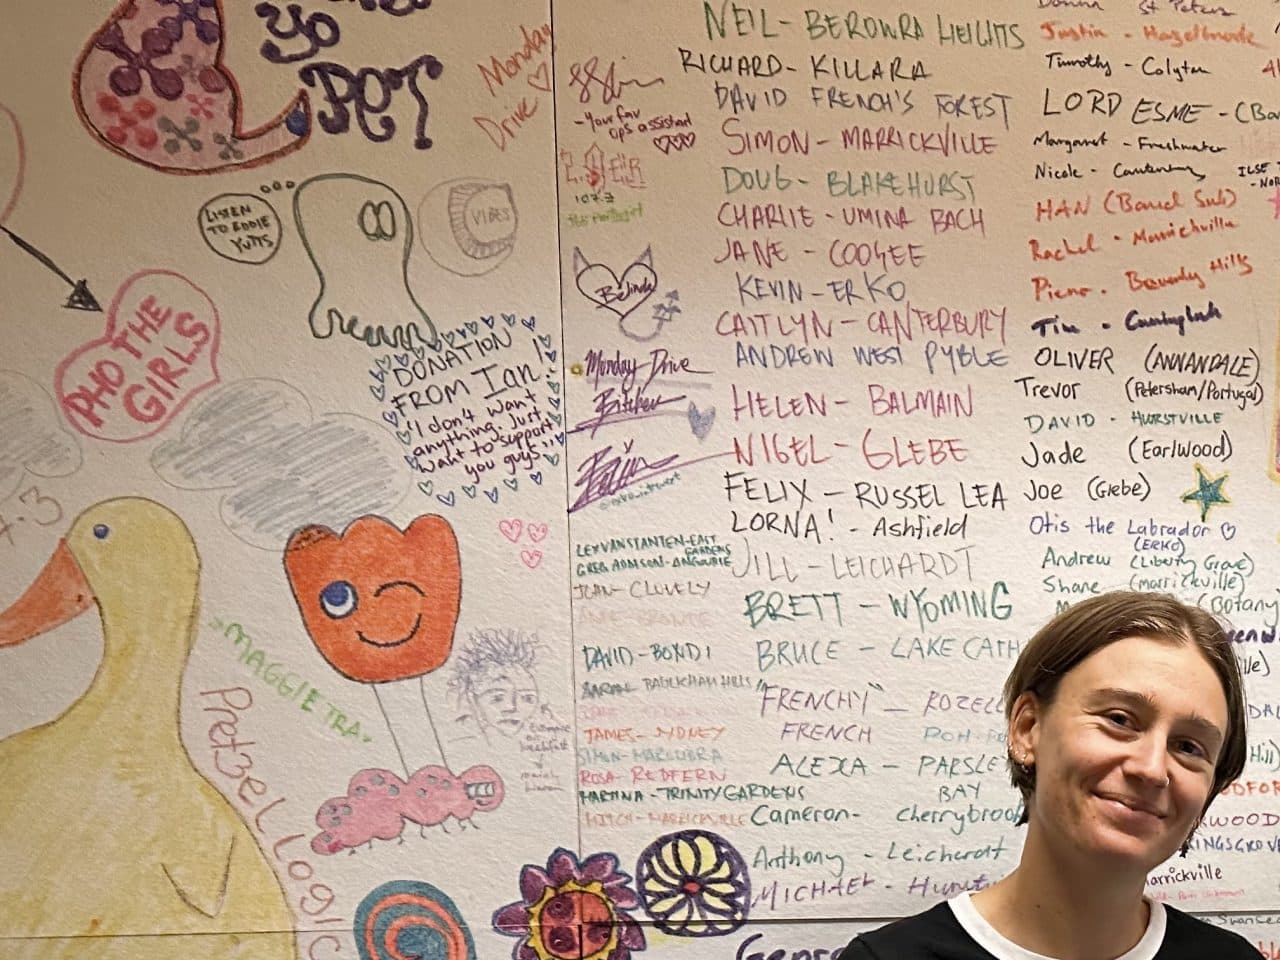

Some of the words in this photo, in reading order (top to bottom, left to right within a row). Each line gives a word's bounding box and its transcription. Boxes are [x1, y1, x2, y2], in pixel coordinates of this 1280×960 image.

[810, 57, 933, 81] KILLARA
[714, 81, 788, 112] DAVID
[1043, 88, 1122, 117] LORD
[475, 97, 538, 151] Drive
[722, 118, 809, 156] SIMON
[828, 173, 975, 203] BLAKEHURST
[930, 207, 986, 237] BACH
[1035, 196, 1090, 222] HAN
[714, 240, 789, 268] JANE
[828, 240, 926, 272] COOGEE
[113, 296, 171, 360] THE
[715, 311, 832, 340] CAITLYN
[867, 303, 1008, 342] CANTERBURY
[122, 311, 210, 423] GIRLS
[393, 327, 512, 388] DONATION
[736, 341, 833, 370] ANDREW
[1035, 347, 1114, 374] OLIVER
[1144, 344, 1260, 386] (ANNANDALE)
[68, 362, 127, 430] PHO
[392, 379, 470, 417] FROM
[487, 388, 536, 417] want
[731, 384, 828, 419] HELEN
[868, 384, 974, 419] BALMAIN
[1014, 376, 1081, 400] Trevor
[1025, 412, 1097, 433] DAVID
[1132, 410, 1225, 427] HURSTVILLE
[417, 449, 465, 473] want
[471, 440, 494, 456] to
[500, 418, 553, 449] support
[734, 434, 830, 468] NIGEL
[862, 427, 969, 471] GLEBE
[1021, 442, 1087, 467] Jade
[465, 459, 495, 484] you
[724, 471, 812, 503] FELIX
[855, 480, 946, 511] RUSSEL
[959, 483, 1008, 512] LEA
[1024, 479, 1064, 502] Joe
[872, 513, 969, 539] Ashfield
[1029, 515, 1071, 535] Otis
[1085, 517, 1115, 536] the
[1127, 518, 1211, 539] Labrador
[730, 544, 800, 583] JILL
[1042, 546, 1112, 570] Andrew
[1043, 575, 1099, 595] Shane
[743, 590, 843, 629] BRETT
[888, 581, 1013, 644] WYOMING
[755, 639, 839, 672] BRUCE
[890, 637, 956, 660] LAKE
[780, 724, 872, 743] FRENCH
[938, 784, 982, 804] BAY
